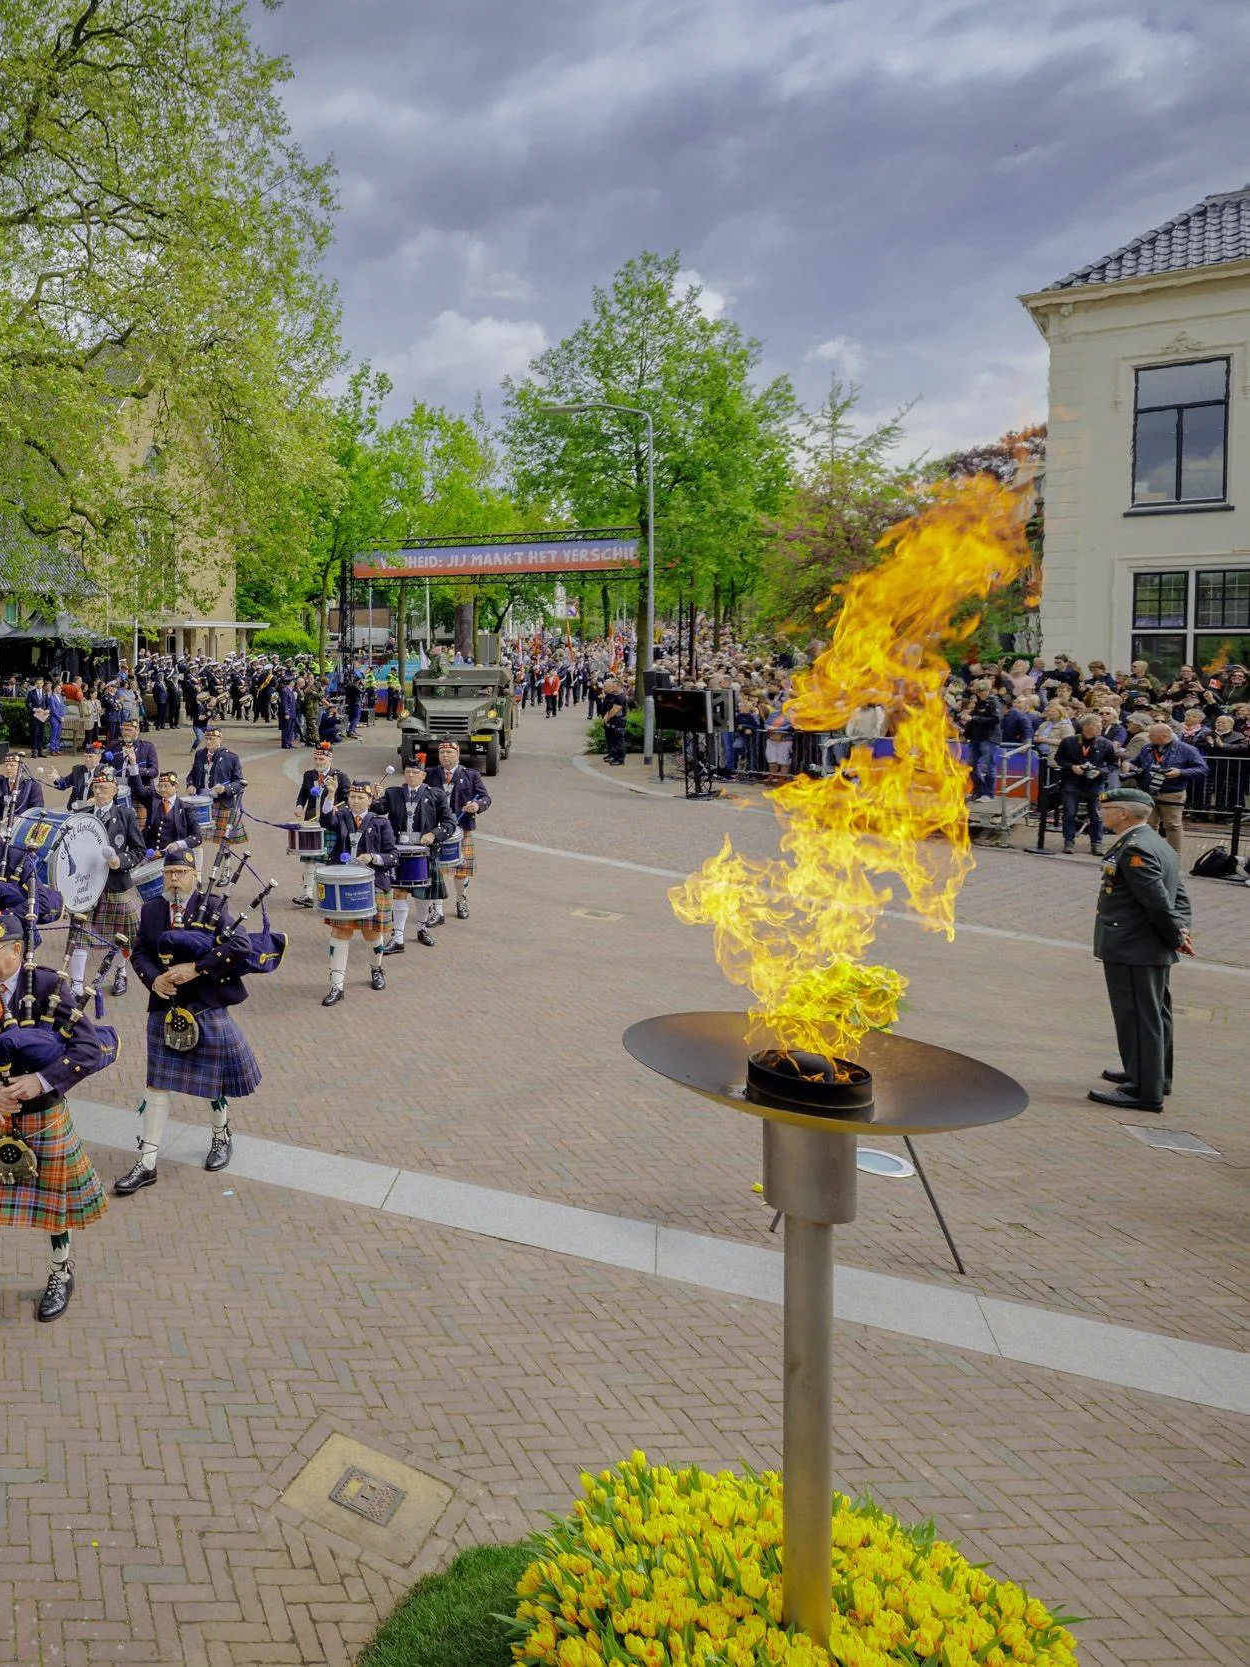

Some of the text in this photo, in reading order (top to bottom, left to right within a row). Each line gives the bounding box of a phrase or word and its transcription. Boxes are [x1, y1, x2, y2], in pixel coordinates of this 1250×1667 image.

[380, 555, 443, 570] VHEID:
[447, 553, 467, 568] JIJ
[471, 551, 524, 567] MAAKT
[528, 550, 558, 564] HET
[77, 882, 89, 894] and
[71, 895, 92, 907] Drums
